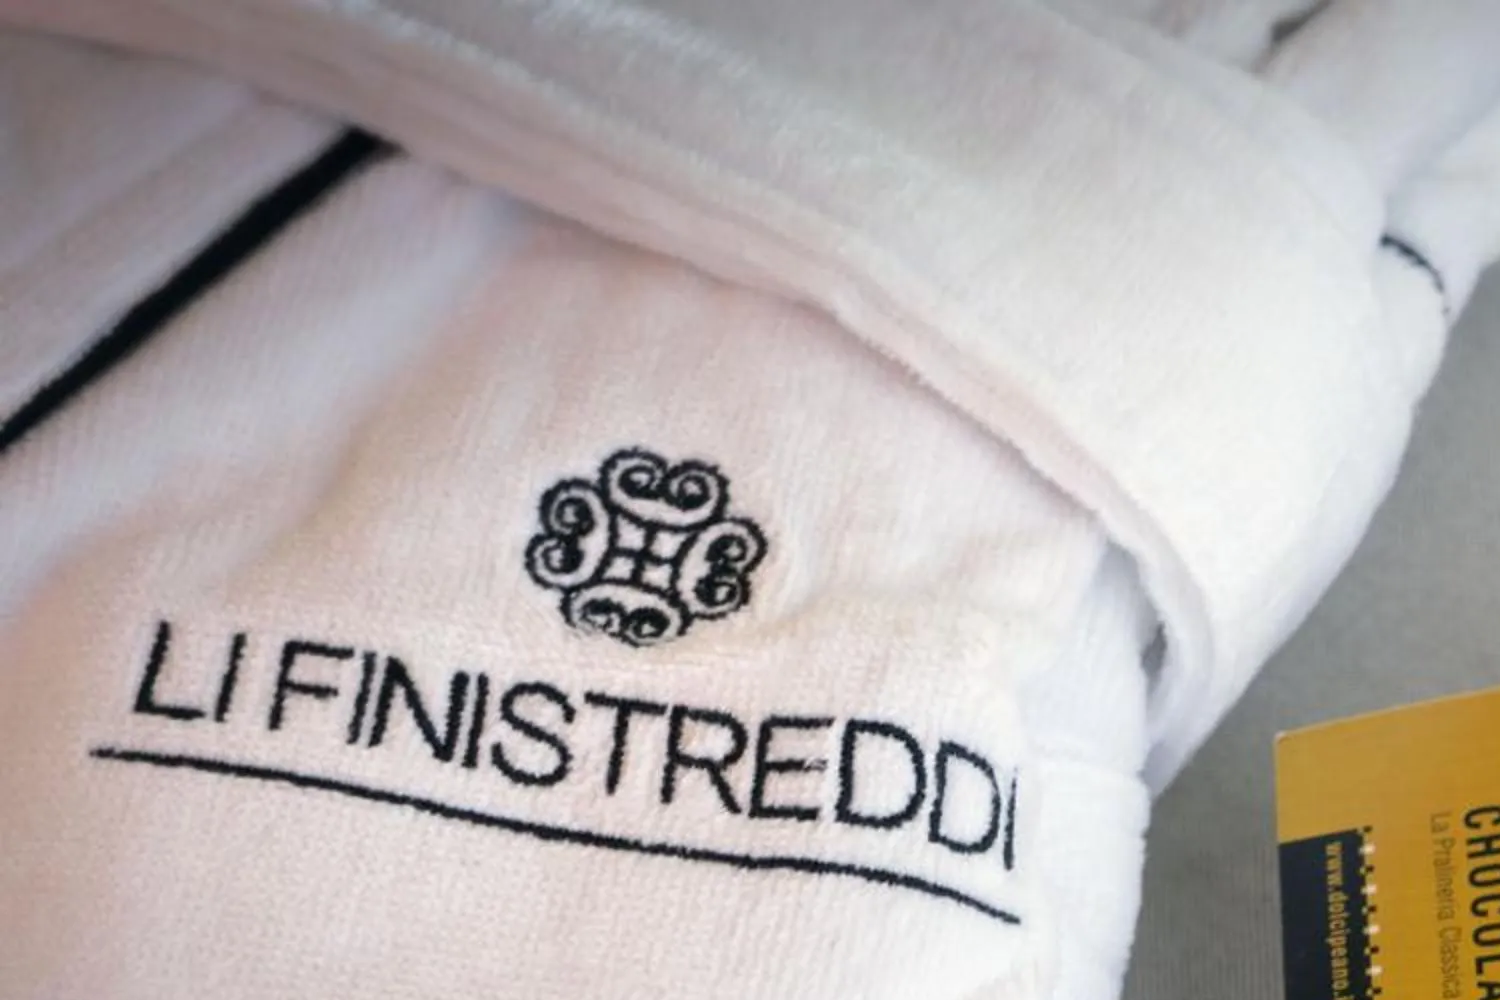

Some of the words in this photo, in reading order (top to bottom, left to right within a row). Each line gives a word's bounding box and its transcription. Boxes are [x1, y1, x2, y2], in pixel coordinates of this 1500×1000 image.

[133, 621, 248, 724] LI
[268, 640, 1019, 871] FINISTREDDI
[1431, 812, 1450, 834] La
[1433, 839, 1457, 921] Pralineria
[1438, 926, 1463, 1000] Classica
